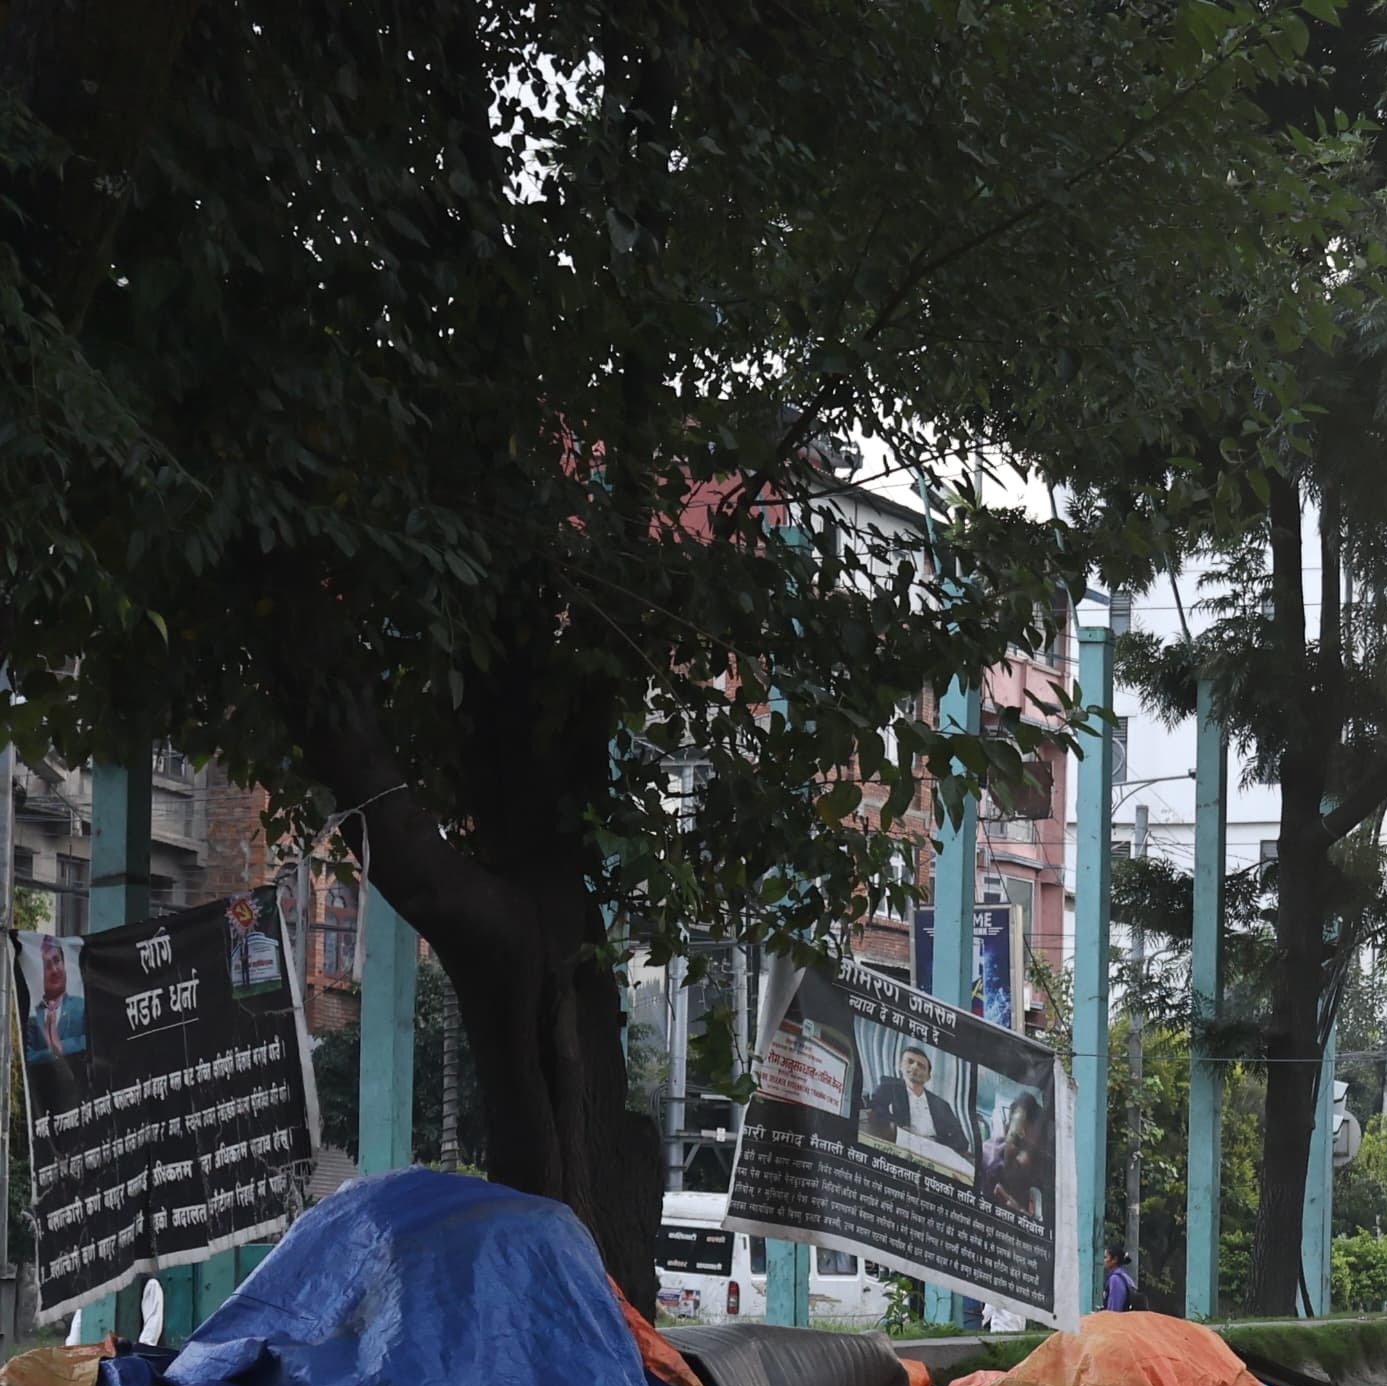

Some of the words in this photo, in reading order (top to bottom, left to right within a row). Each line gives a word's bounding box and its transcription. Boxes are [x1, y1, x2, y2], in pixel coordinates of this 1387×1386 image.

[848, 994, 877, 1016] न्याय
[879, 1003, 889, 1023] दे
[892, 1012, 905, 1028] या
[771, 1130, 806, 1148] प्रमोद
[871, 1155, 921, 1184] अधिकृतलाई
